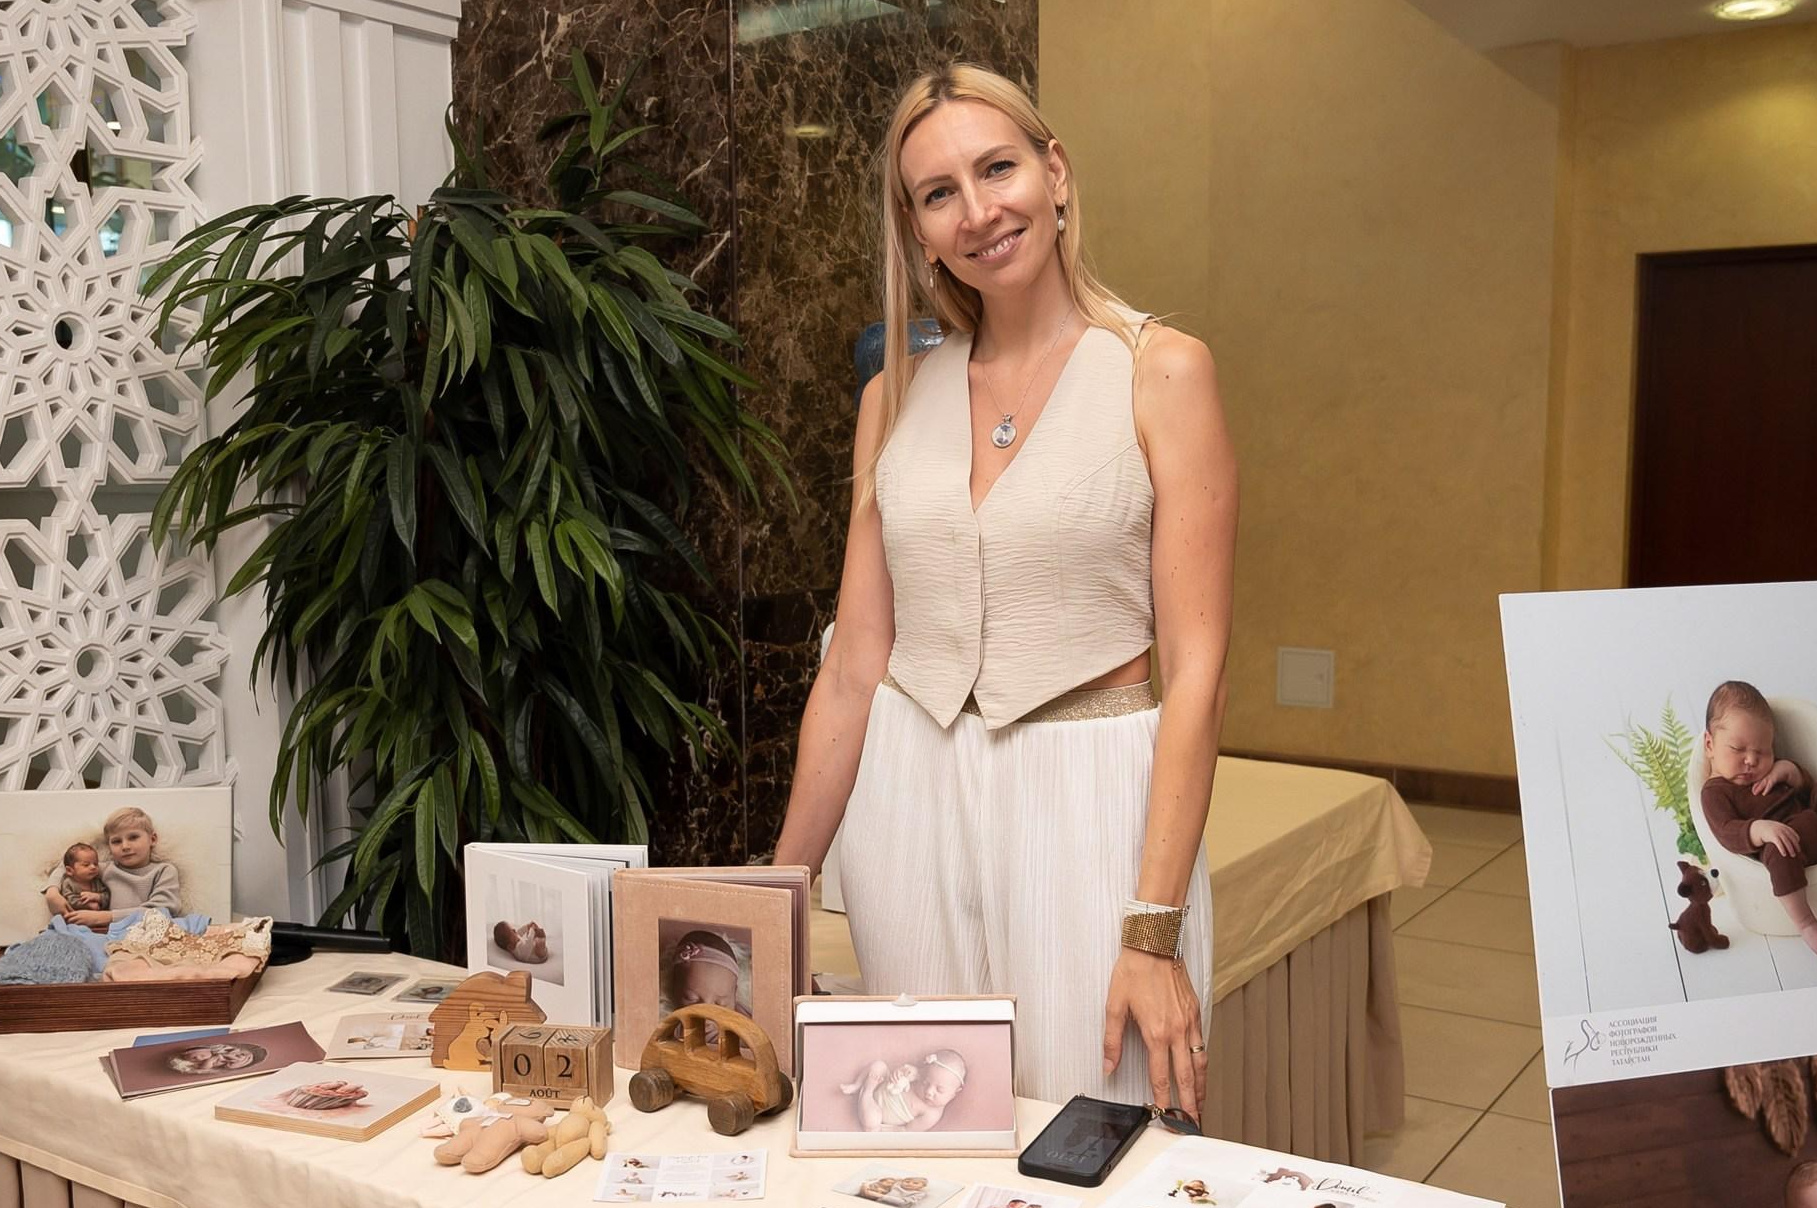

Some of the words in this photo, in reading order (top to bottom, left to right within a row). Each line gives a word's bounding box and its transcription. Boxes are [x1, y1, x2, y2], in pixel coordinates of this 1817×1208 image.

[1609, 1016, 1657, 1028] АССОЦИАЦИЯ
[1609, 1026, 1657, 1038] ФОТОГРАФОВ
[1611, 1045, 1658, 1057] РЕСПУБЛИКИ
[1612, 1055, 1651, 1066] ТАТАРСТАН
[530, 1088, 560, 1098] AOÛT
